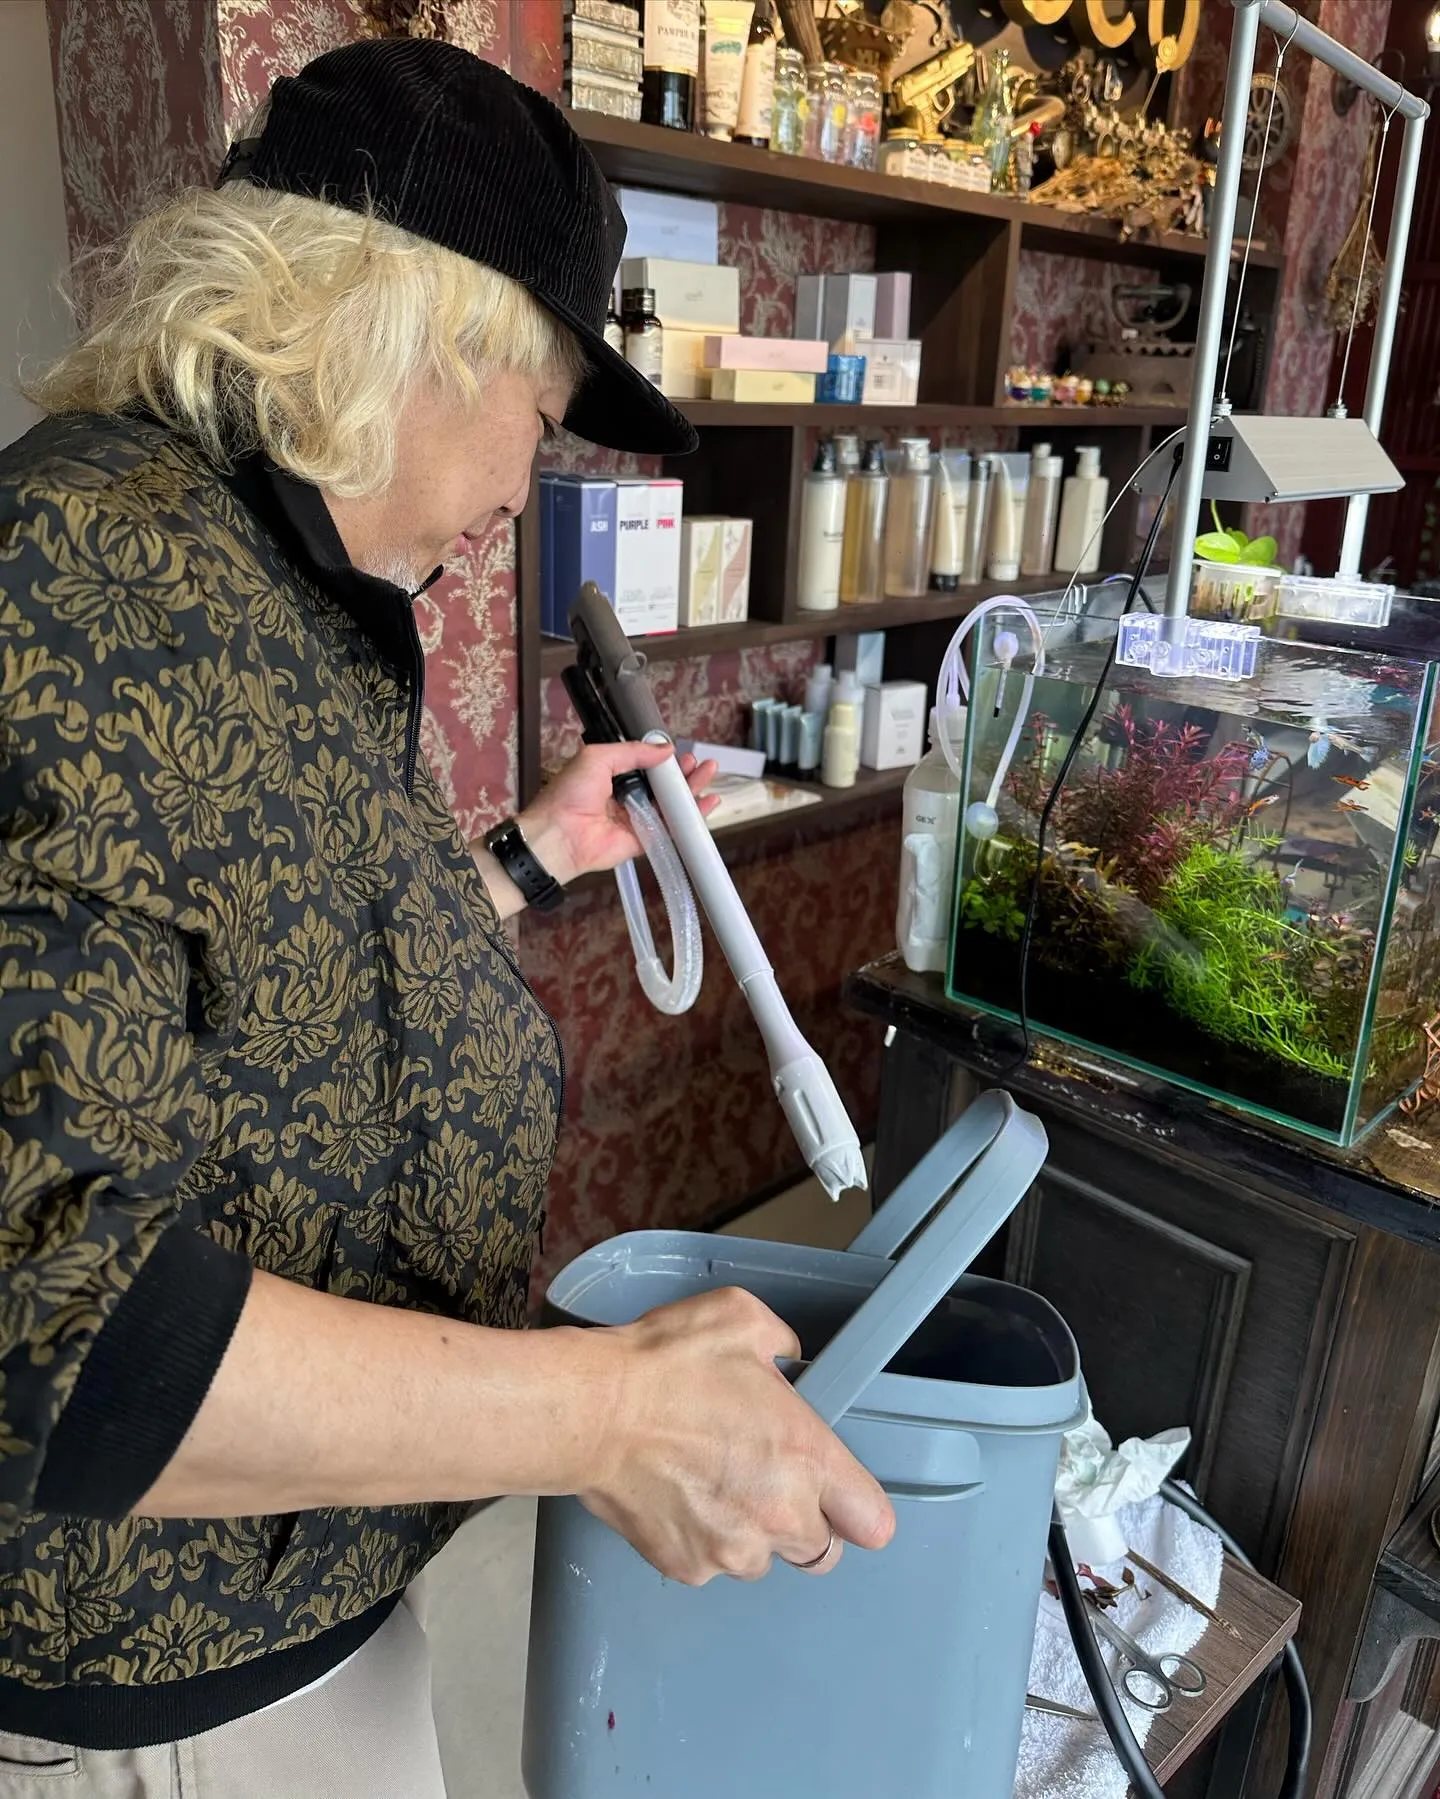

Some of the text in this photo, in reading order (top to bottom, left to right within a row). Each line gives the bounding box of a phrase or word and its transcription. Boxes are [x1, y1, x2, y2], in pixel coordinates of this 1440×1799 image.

[590, 519, 609, 533] ASH
[619, 519, 649, 531] PURPLE
[656, 518, 676, 529] PINK
